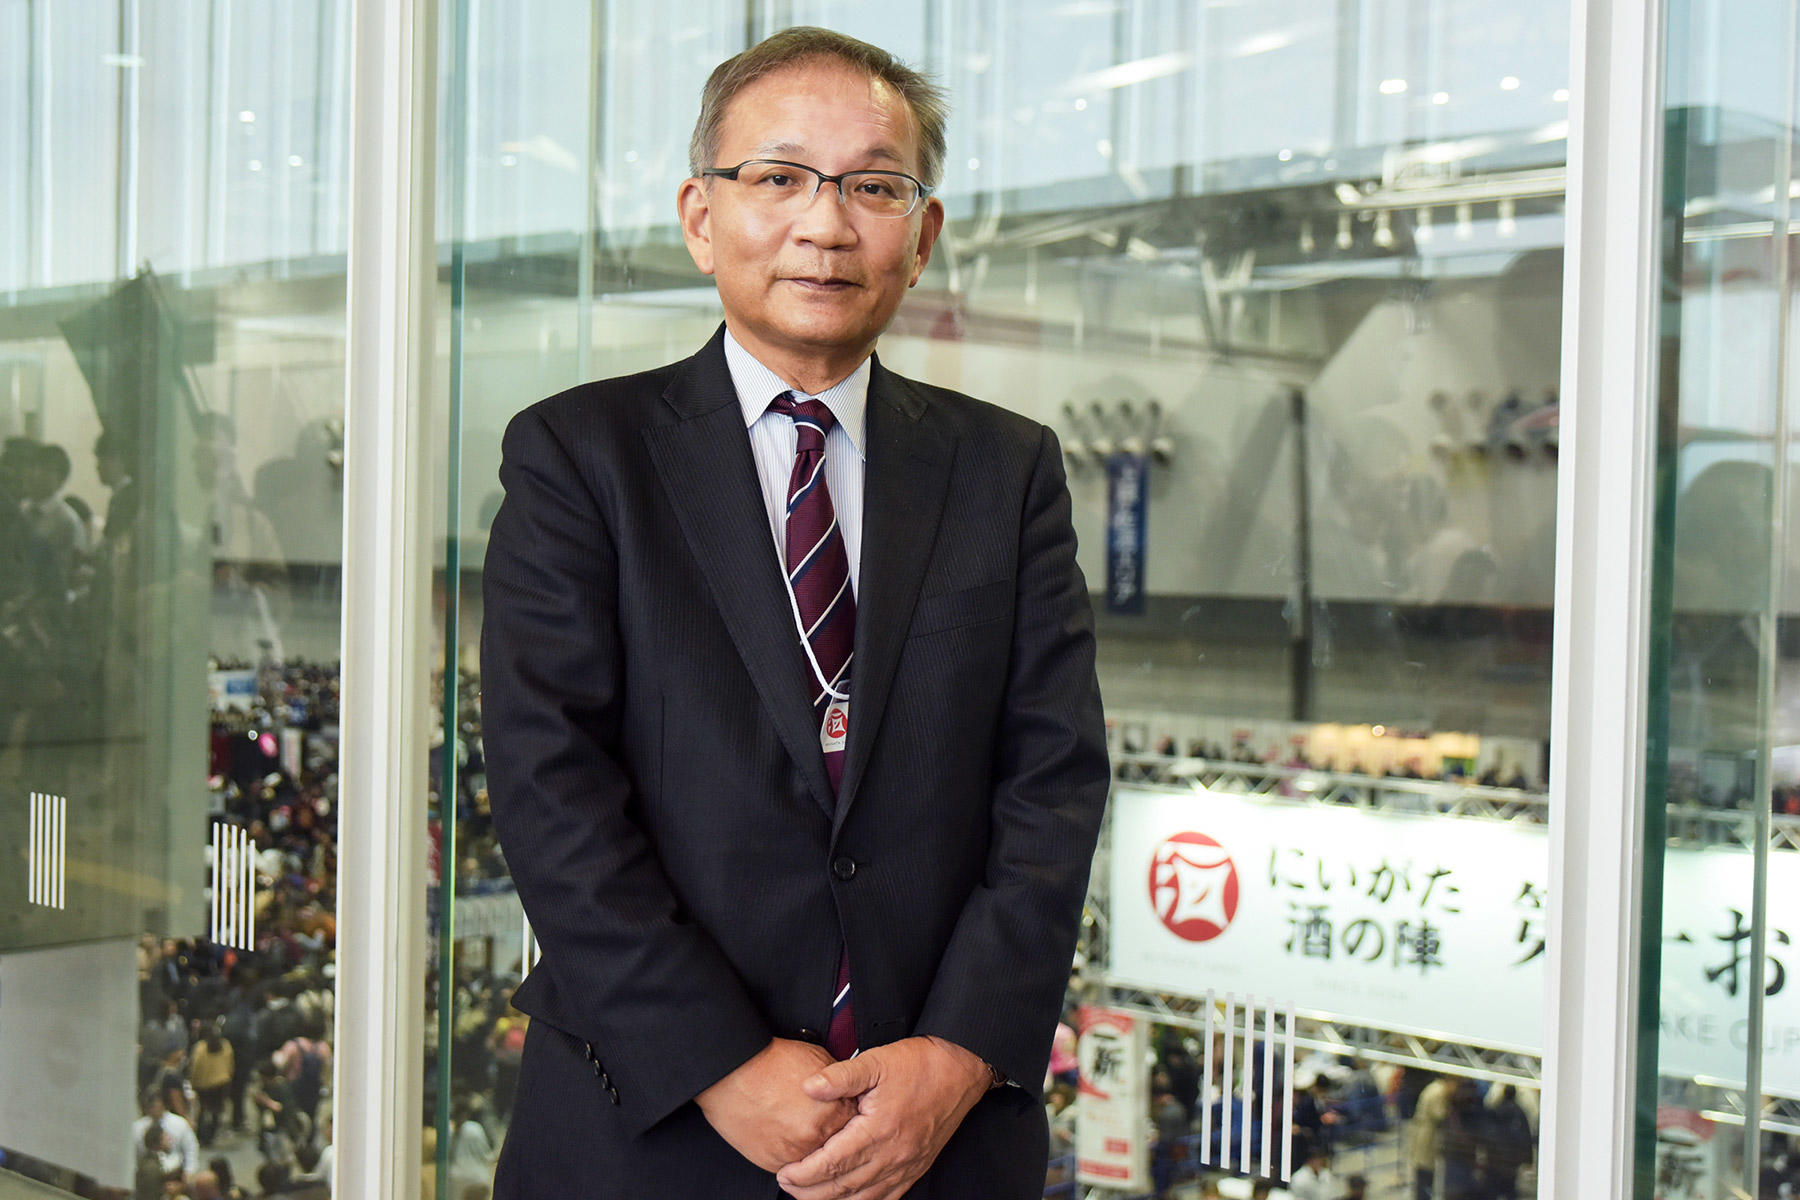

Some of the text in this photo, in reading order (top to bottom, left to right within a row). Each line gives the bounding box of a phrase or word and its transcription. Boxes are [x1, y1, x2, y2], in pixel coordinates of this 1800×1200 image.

[1268, 847, 1461, 914] にいがた
[1285, 903, 1445, 976] 酒の陣
